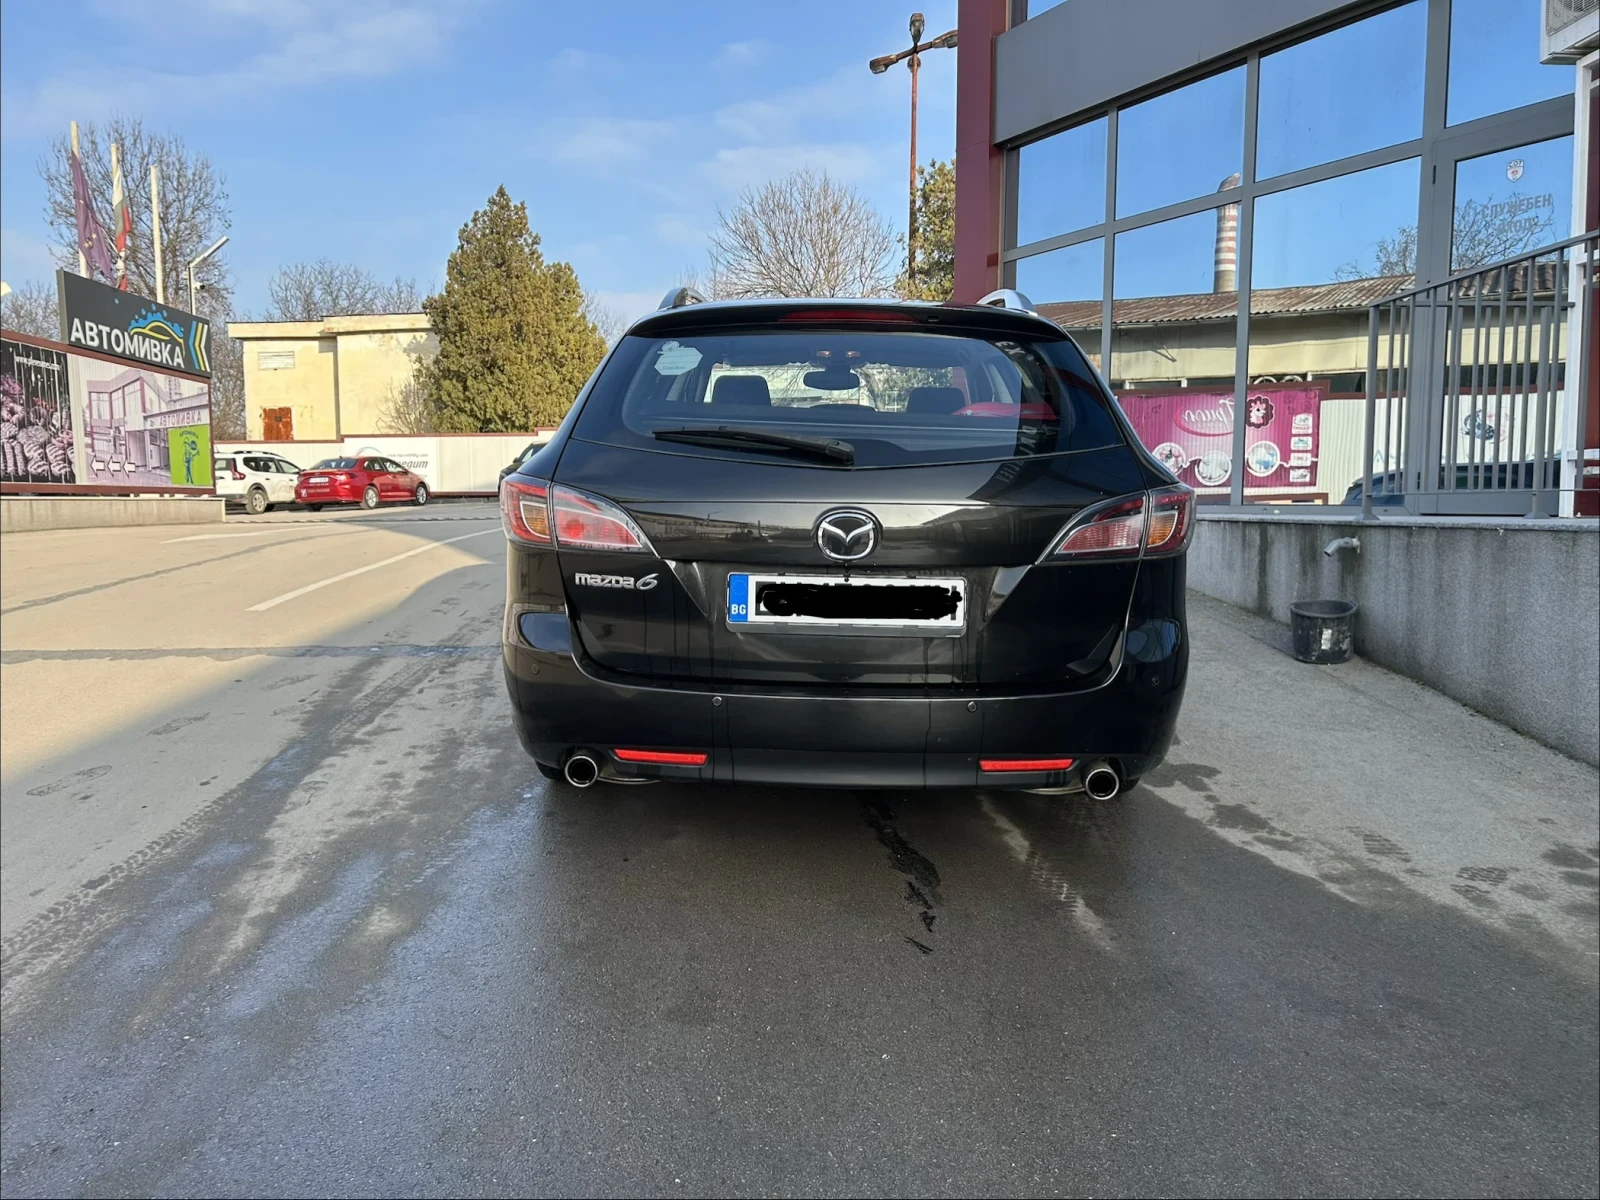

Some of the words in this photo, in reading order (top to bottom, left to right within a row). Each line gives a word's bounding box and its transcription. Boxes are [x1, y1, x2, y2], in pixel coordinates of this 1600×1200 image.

[1481, 193, 1552, 219] СЛУЖЕБЕН
[70, 317, 185, 369] АВТОМИВКА
[159, 410, 202, 427] АВТОМИВКА
[731, 604, 747, 615] BG
